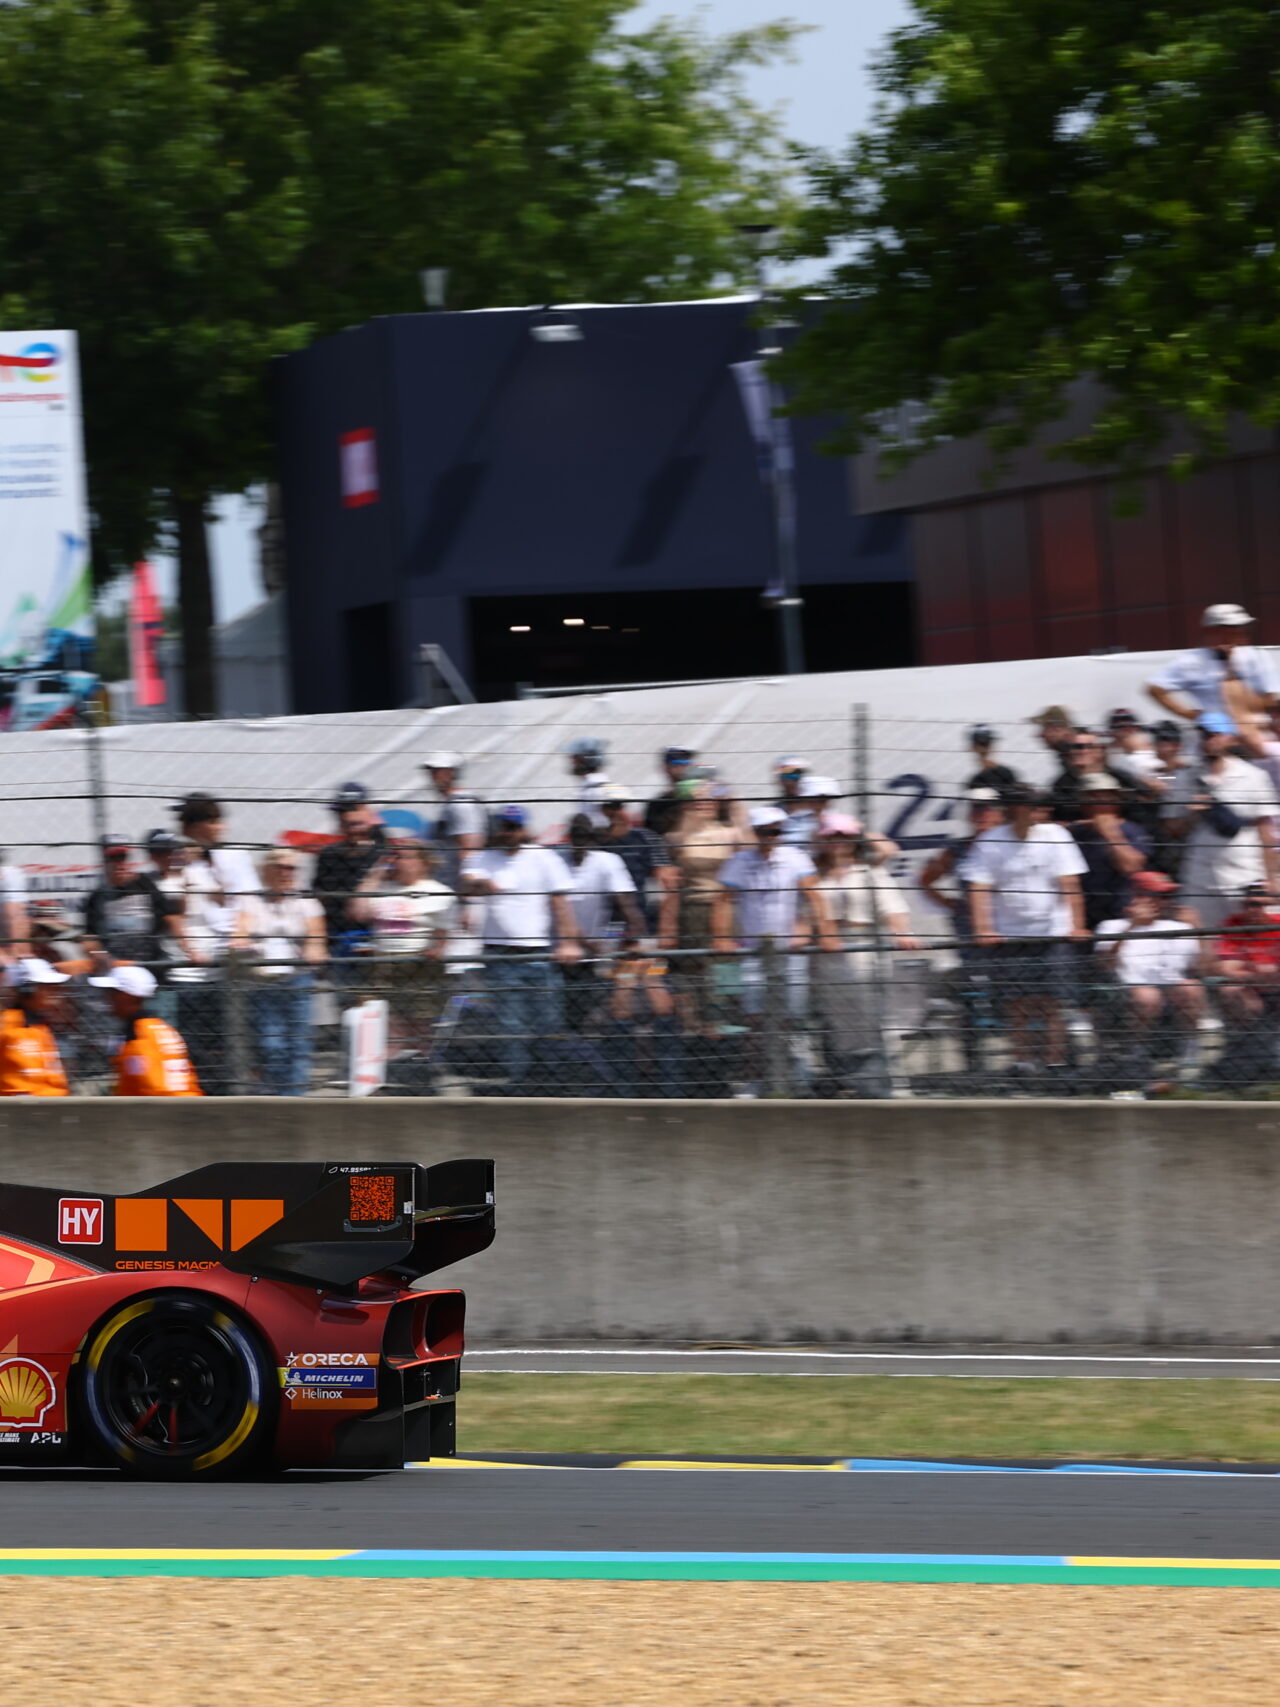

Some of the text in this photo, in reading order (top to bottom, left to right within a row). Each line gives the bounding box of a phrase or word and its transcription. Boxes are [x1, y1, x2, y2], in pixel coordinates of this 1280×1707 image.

[62, 1207, 100, 1235] HY
[115, 1260, 175, 1270] GENESIS
[302, 1353, 368, 1366] ORECA
[304, 1374, 364, 1383] MICHELIN
[302, 1388, 343, 1399] Helinox
